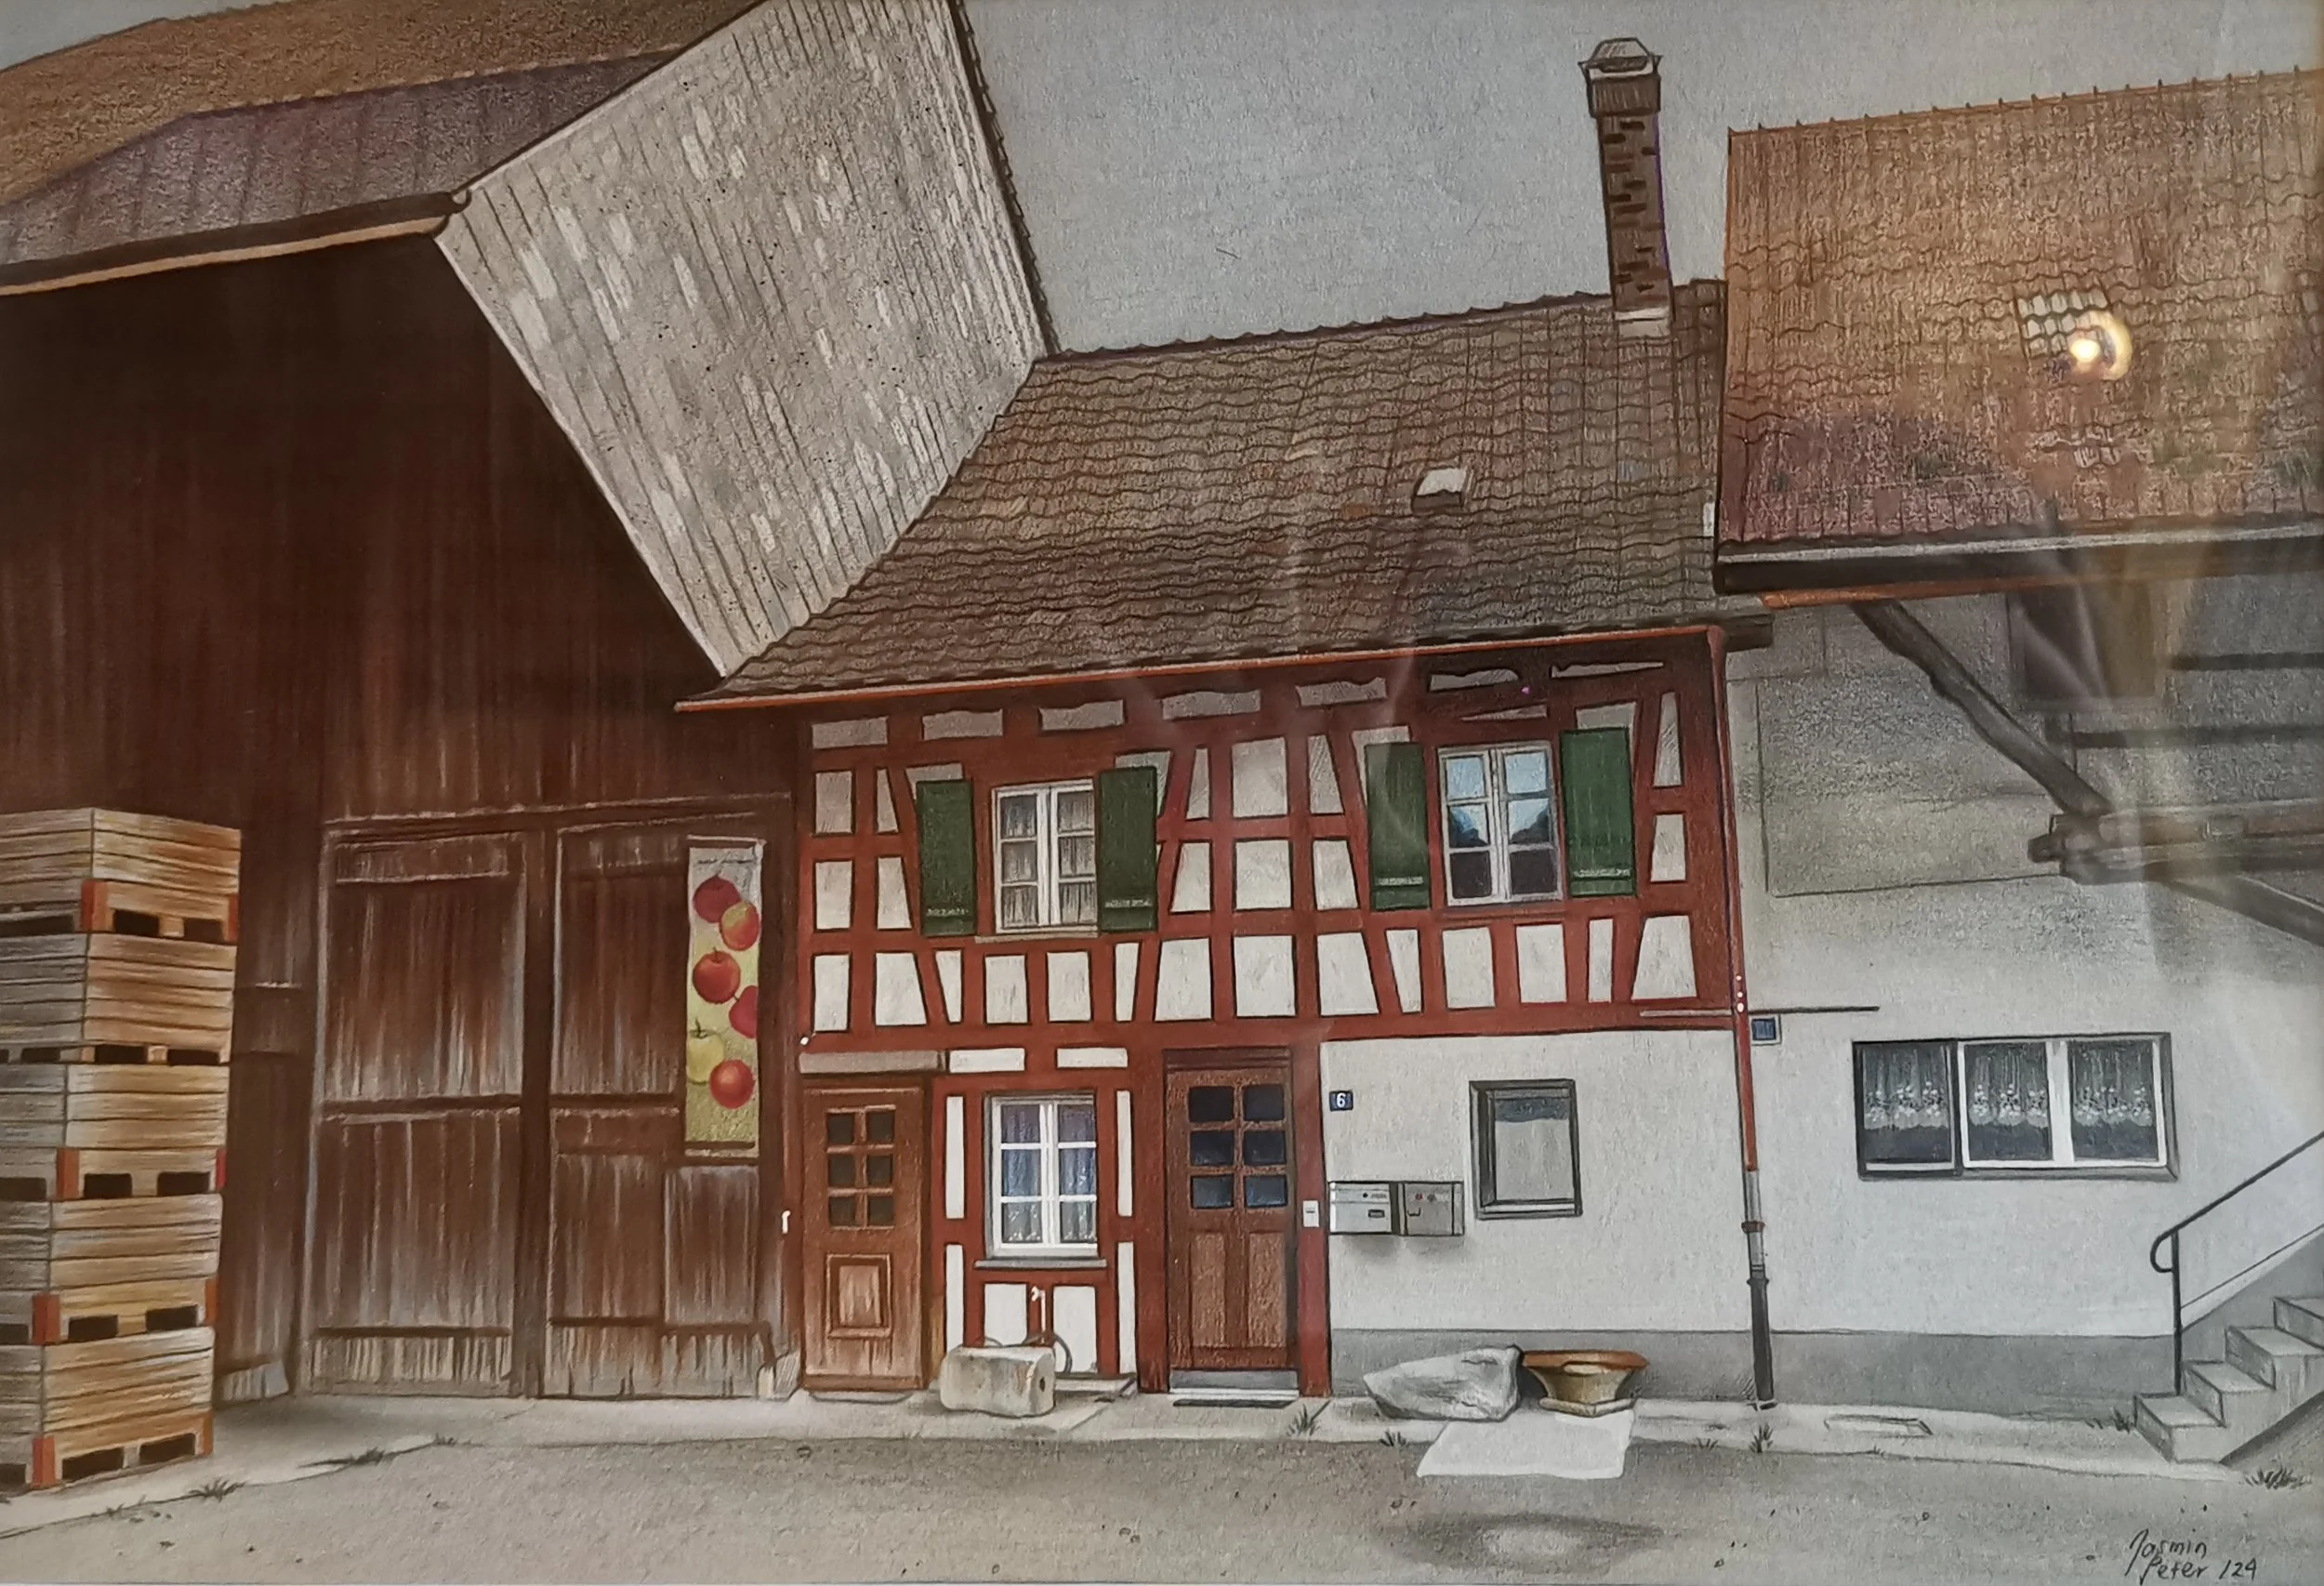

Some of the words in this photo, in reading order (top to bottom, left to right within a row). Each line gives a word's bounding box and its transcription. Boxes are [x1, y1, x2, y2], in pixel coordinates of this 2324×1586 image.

[1336, 1092, 1346, 1108] 6
[2124, 1528, 2207, 1577] Jasmin
[2139, 1553, 2208, 1585] Peter
